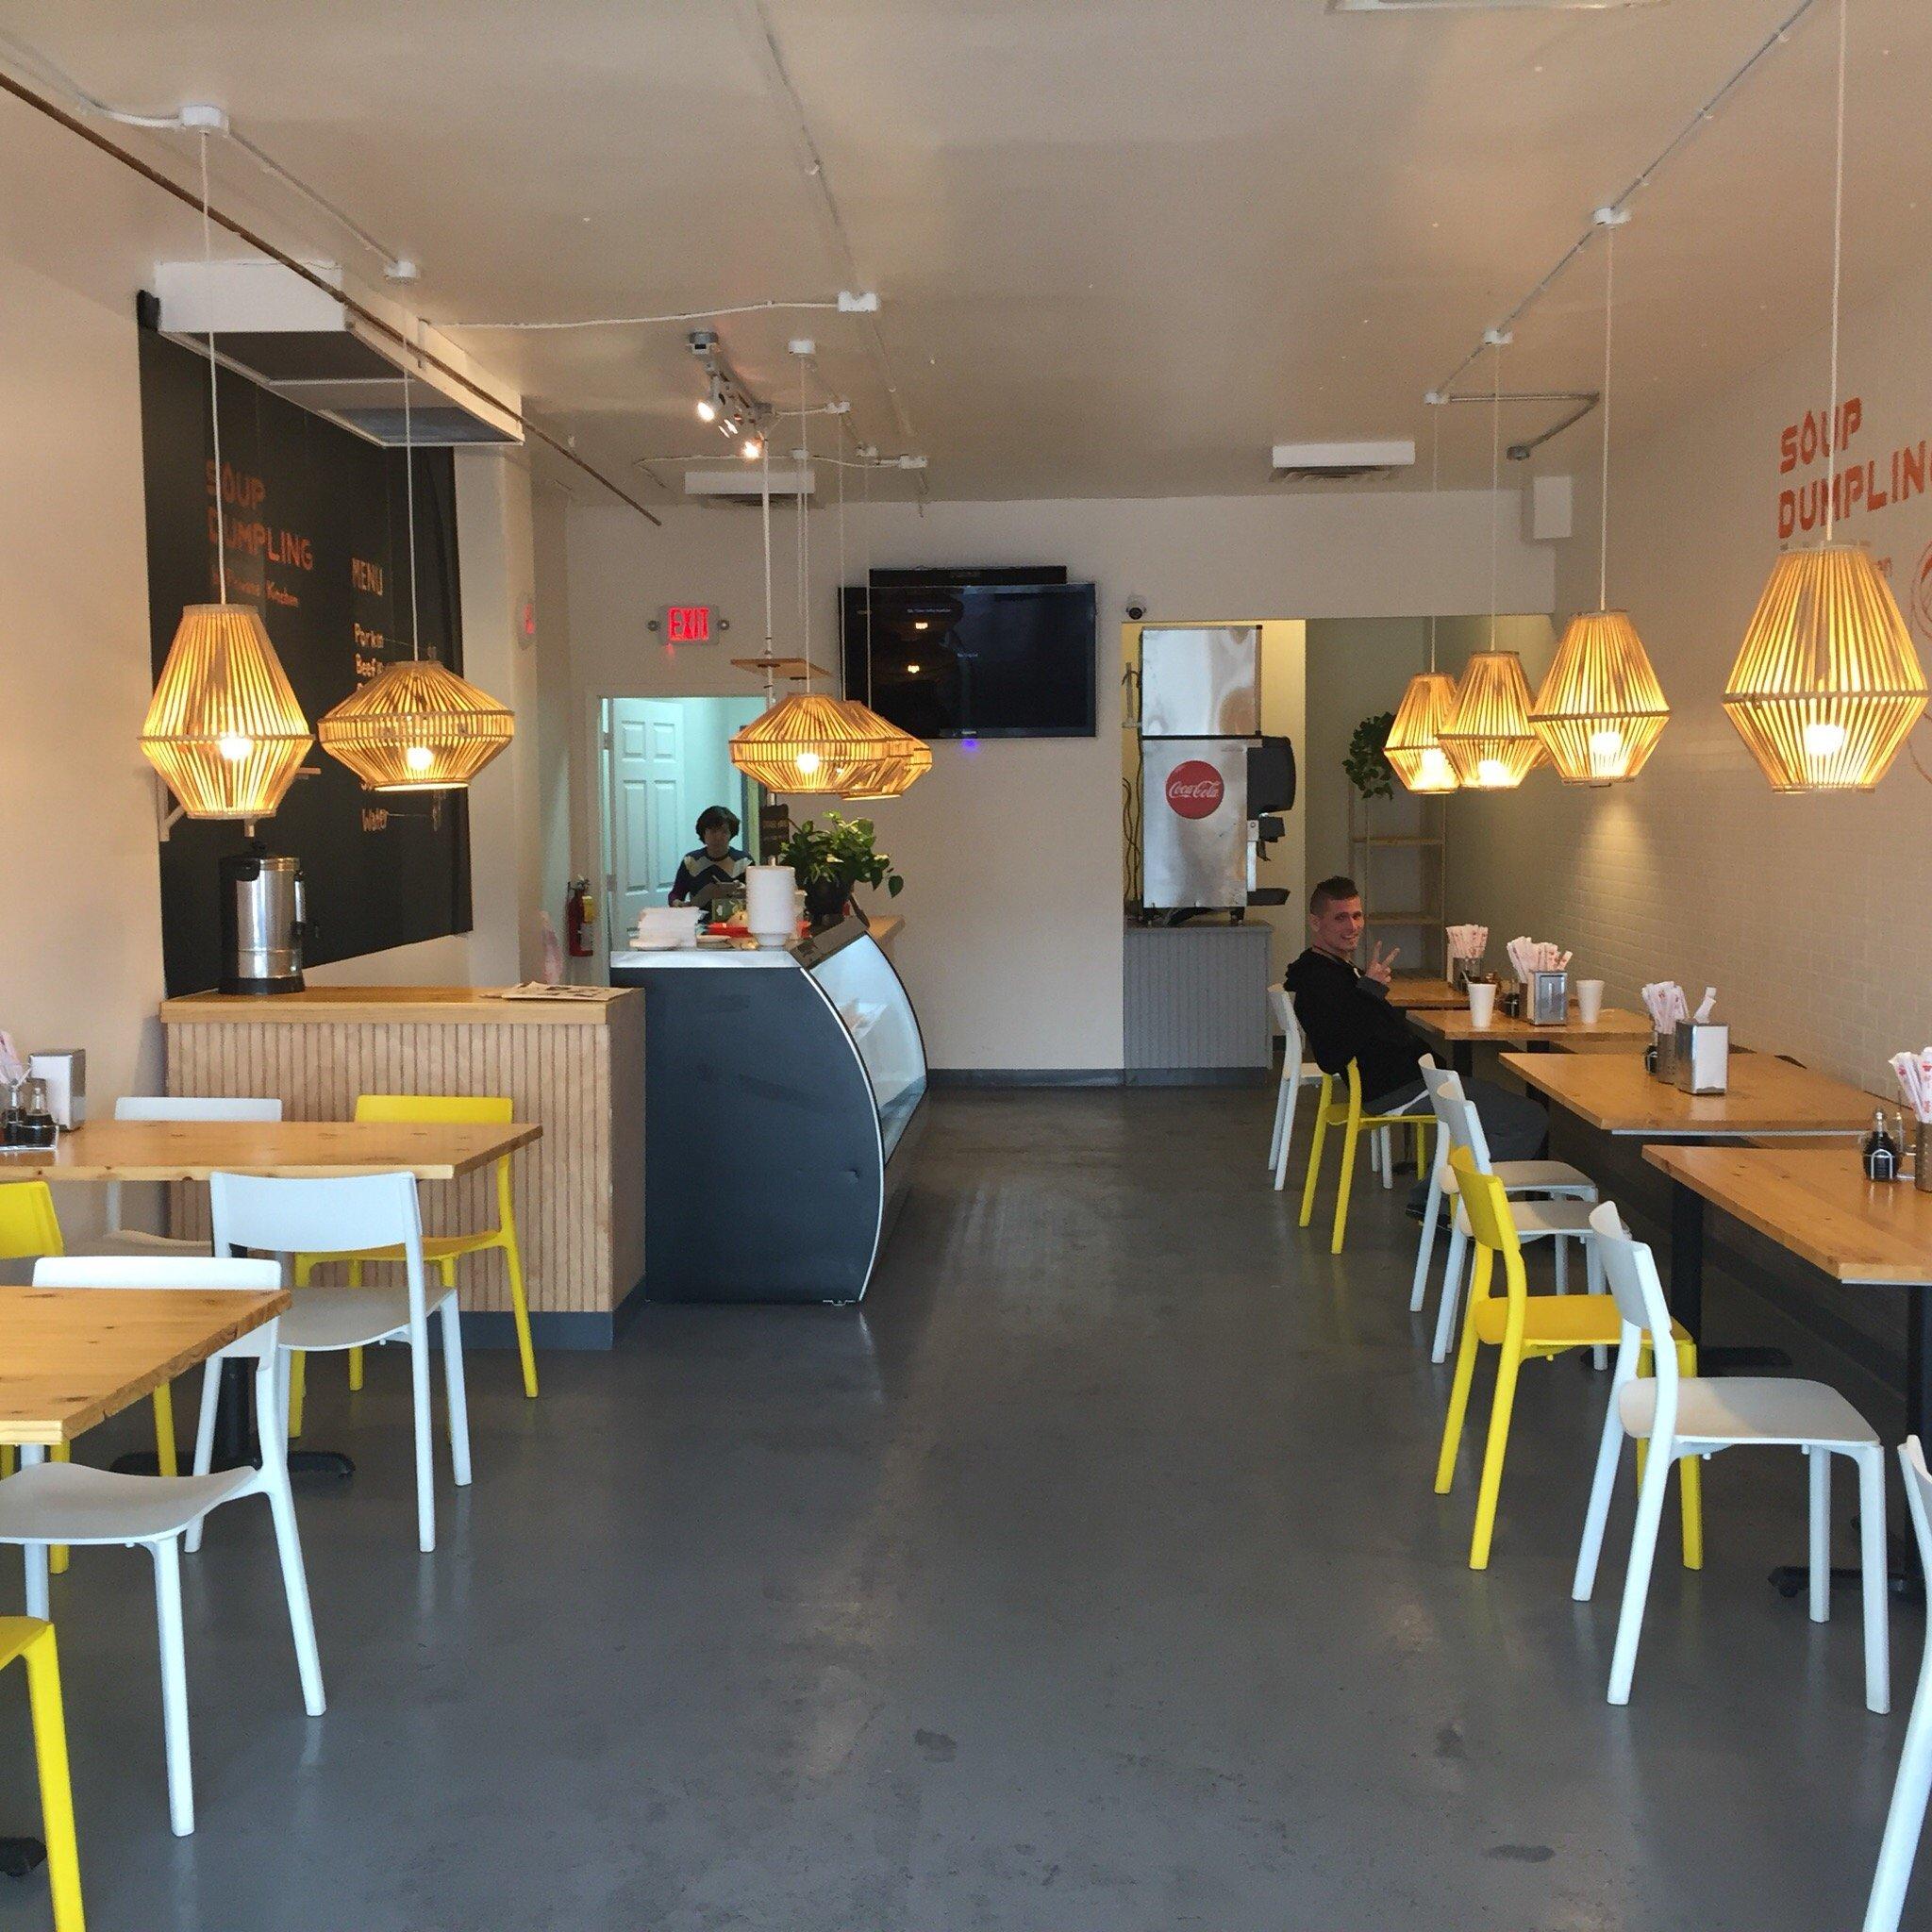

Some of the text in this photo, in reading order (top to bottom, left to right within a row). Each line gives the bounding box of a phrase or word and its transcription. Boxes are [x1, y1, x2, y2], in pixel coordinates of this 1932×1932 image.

[1779, 397, 1862, 475] SOUP
[206, 459, 266, 509] SOUP
[1778, 440, 1932, 539] DUMPLIN
[352, 558, 383, 596] MENU
[669, 607, 708, 641] EXIT
